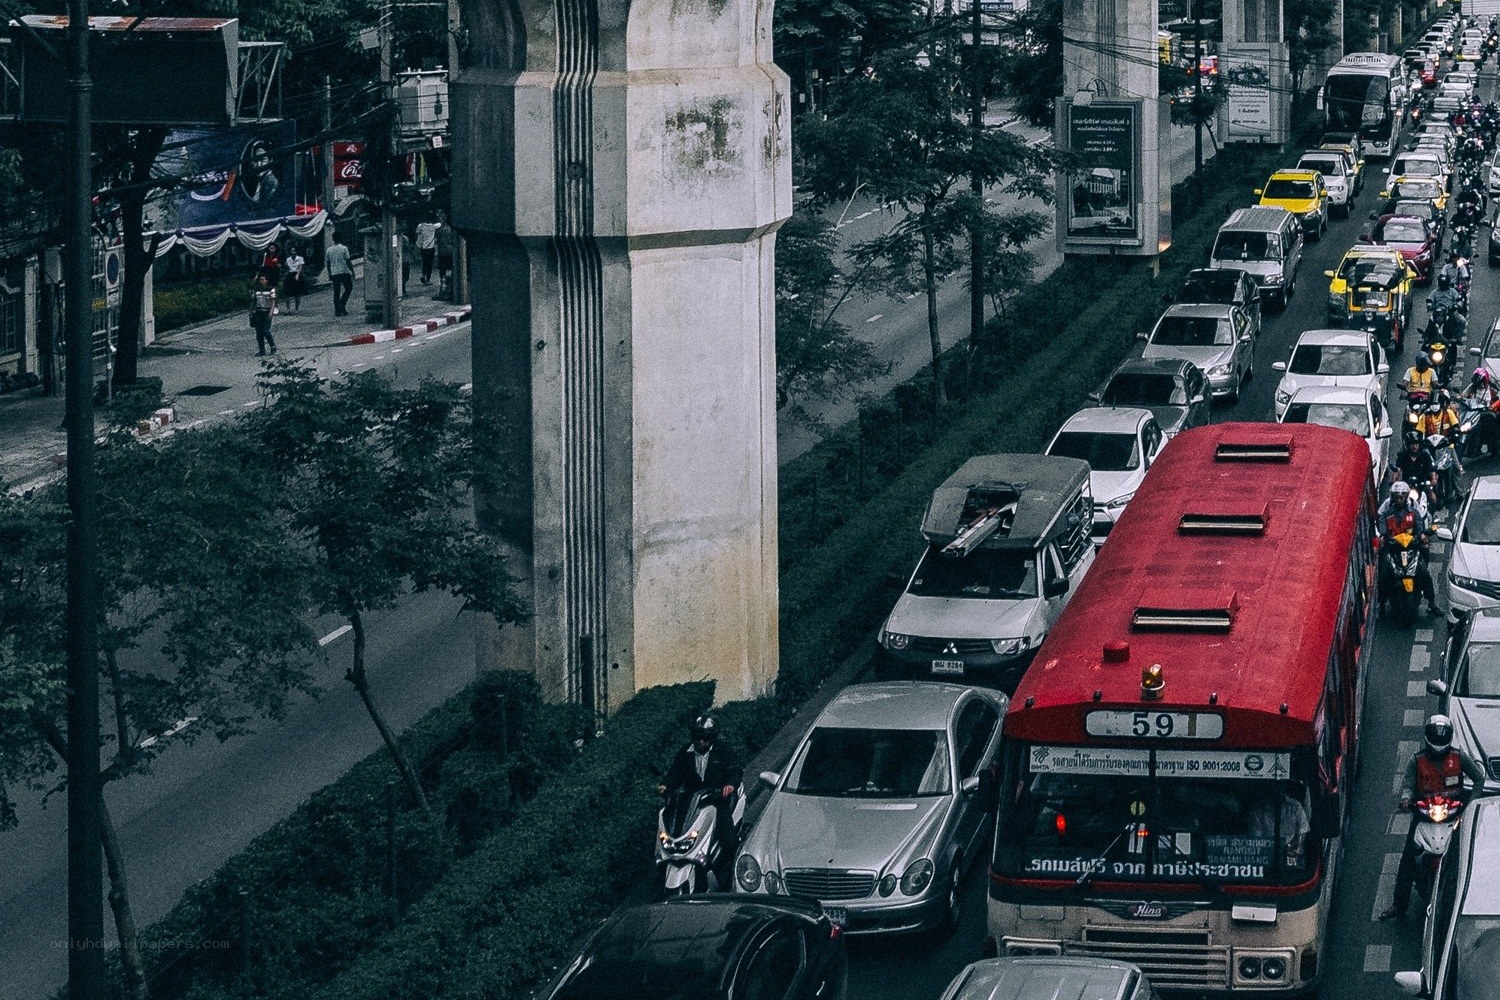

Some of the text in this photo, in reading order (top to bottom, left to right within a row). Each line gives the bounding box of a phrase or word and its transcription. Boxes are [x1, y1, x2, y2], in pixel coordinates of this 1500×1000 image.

[1132, 712, 1174, 737] 59
[1186, 760, 1200, 771] ISO
[1202, 760, 1241, 772] 9001:2008
[1113, 861, 1145, 875] จาก
[1133, 904, 1162, 917] Hino
